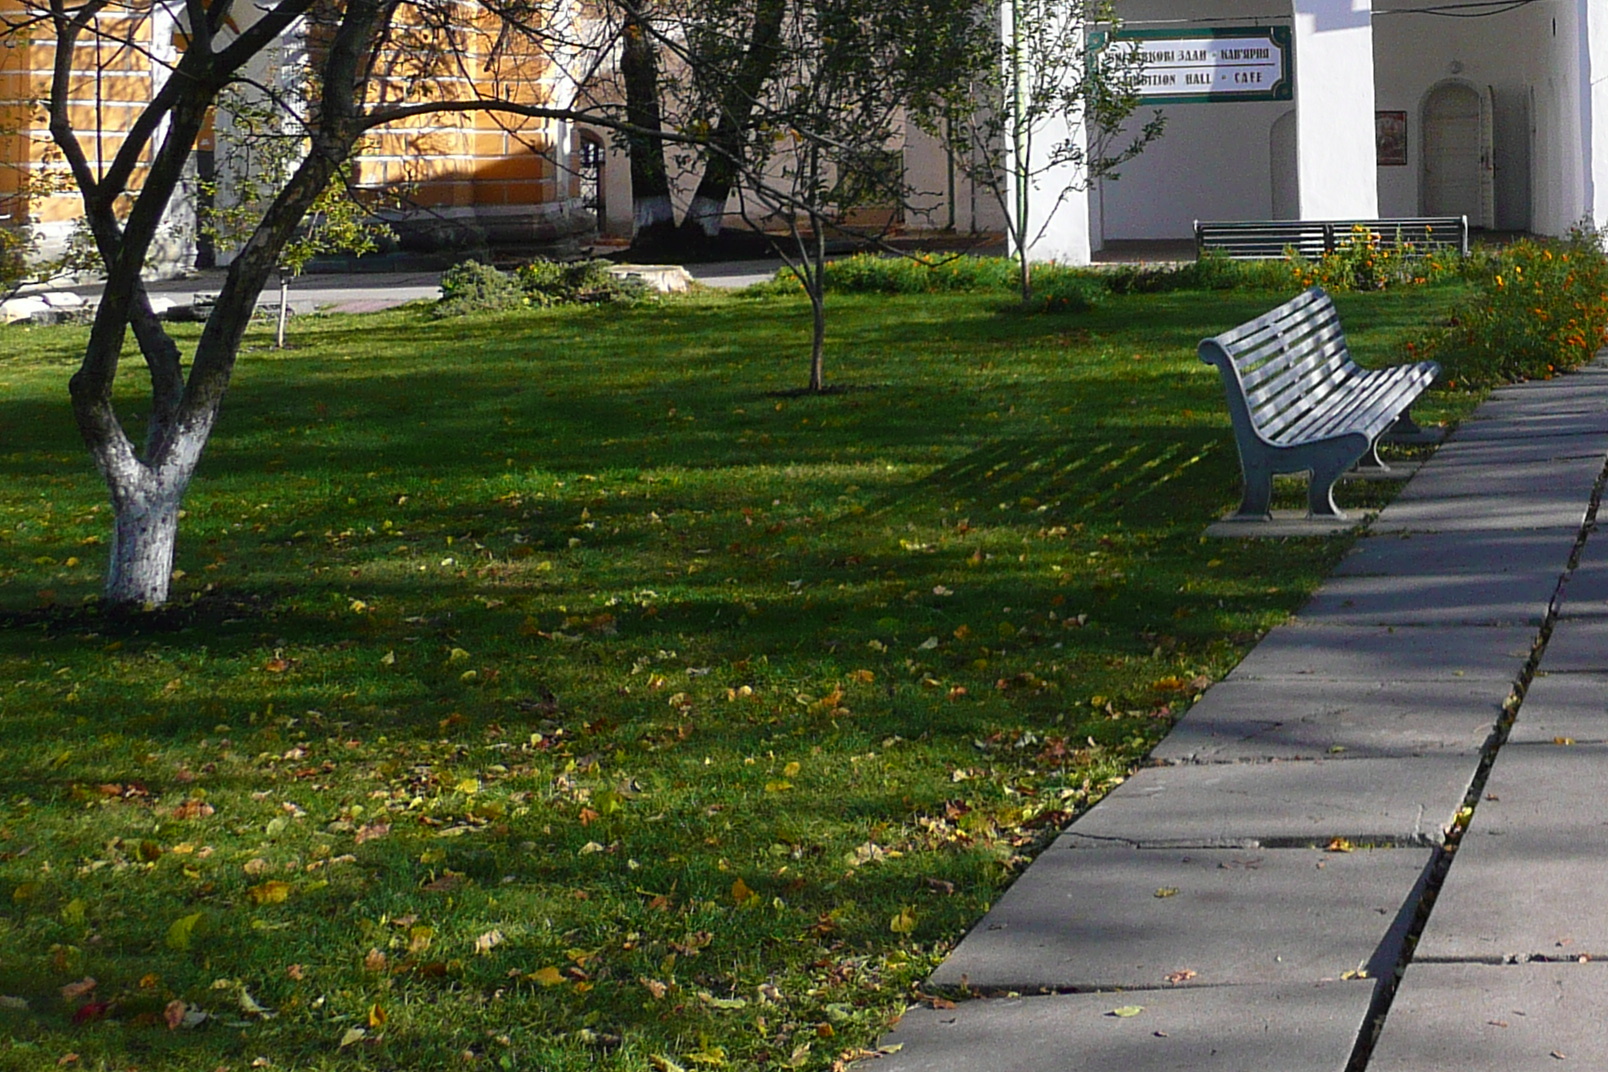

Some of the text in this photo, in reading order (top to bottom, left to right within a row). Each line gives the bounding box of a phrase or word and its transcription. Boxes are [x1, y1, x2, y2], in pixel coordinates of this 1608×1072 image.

[1220, 47, 1270, 60] КАВ'ЯРНЯ
[1185, 73, 1212, 85] HALL
[1234, 71, 1263, 84] CAFE
